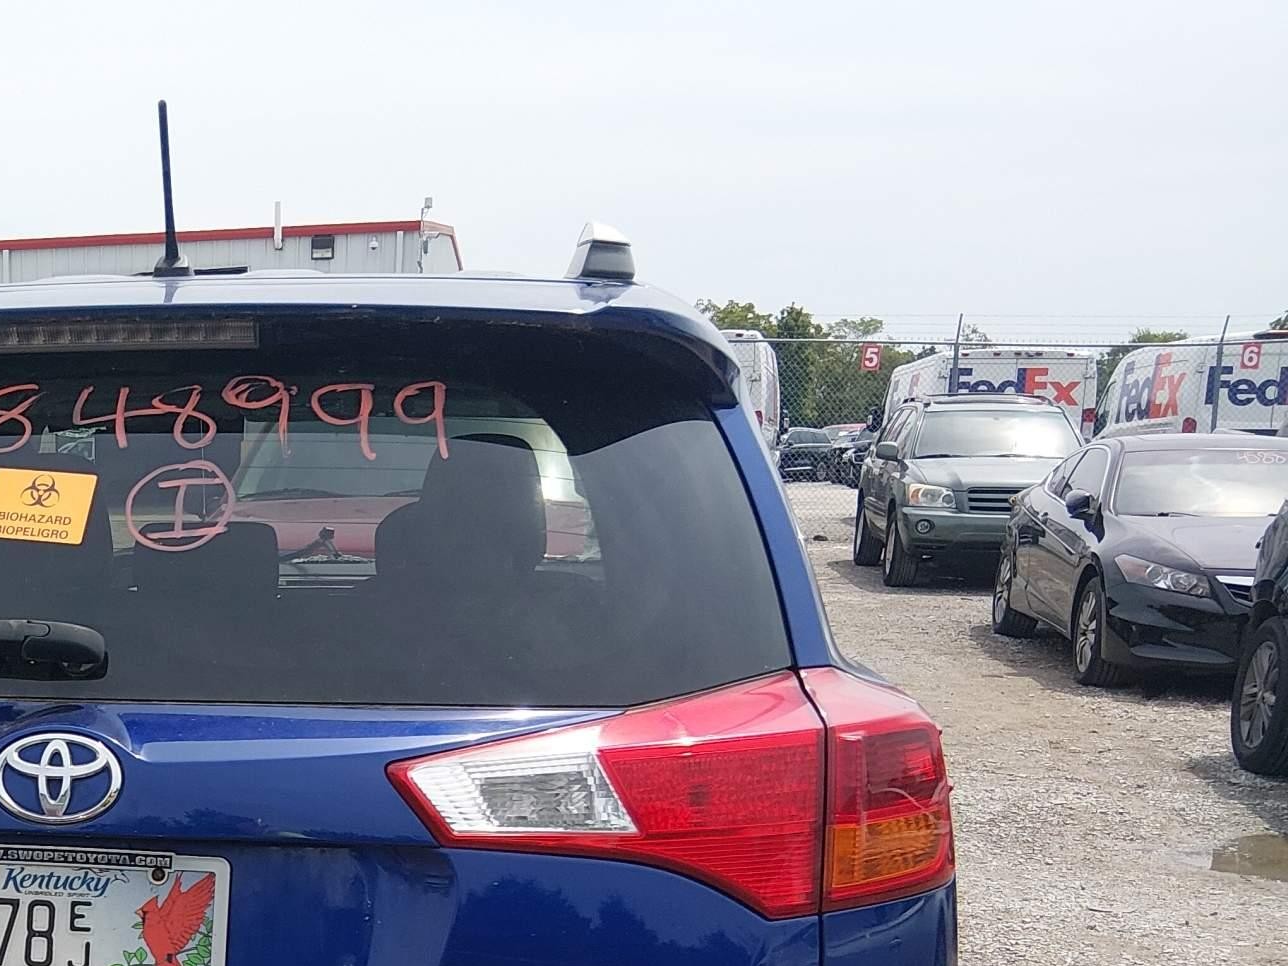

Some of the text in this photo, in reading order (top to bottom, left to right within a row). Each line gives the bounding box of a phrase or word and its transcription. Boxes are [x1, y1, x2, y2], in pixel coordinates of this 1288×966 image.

[863, 347, 880, 369] 5
[1243, 346, 1259, 367] 6
[1114, 351, 1187, 424] FedEx
[1, 866, 111, 898] Kentucky
[24, 890, 64, 898] UNBRIDLED
